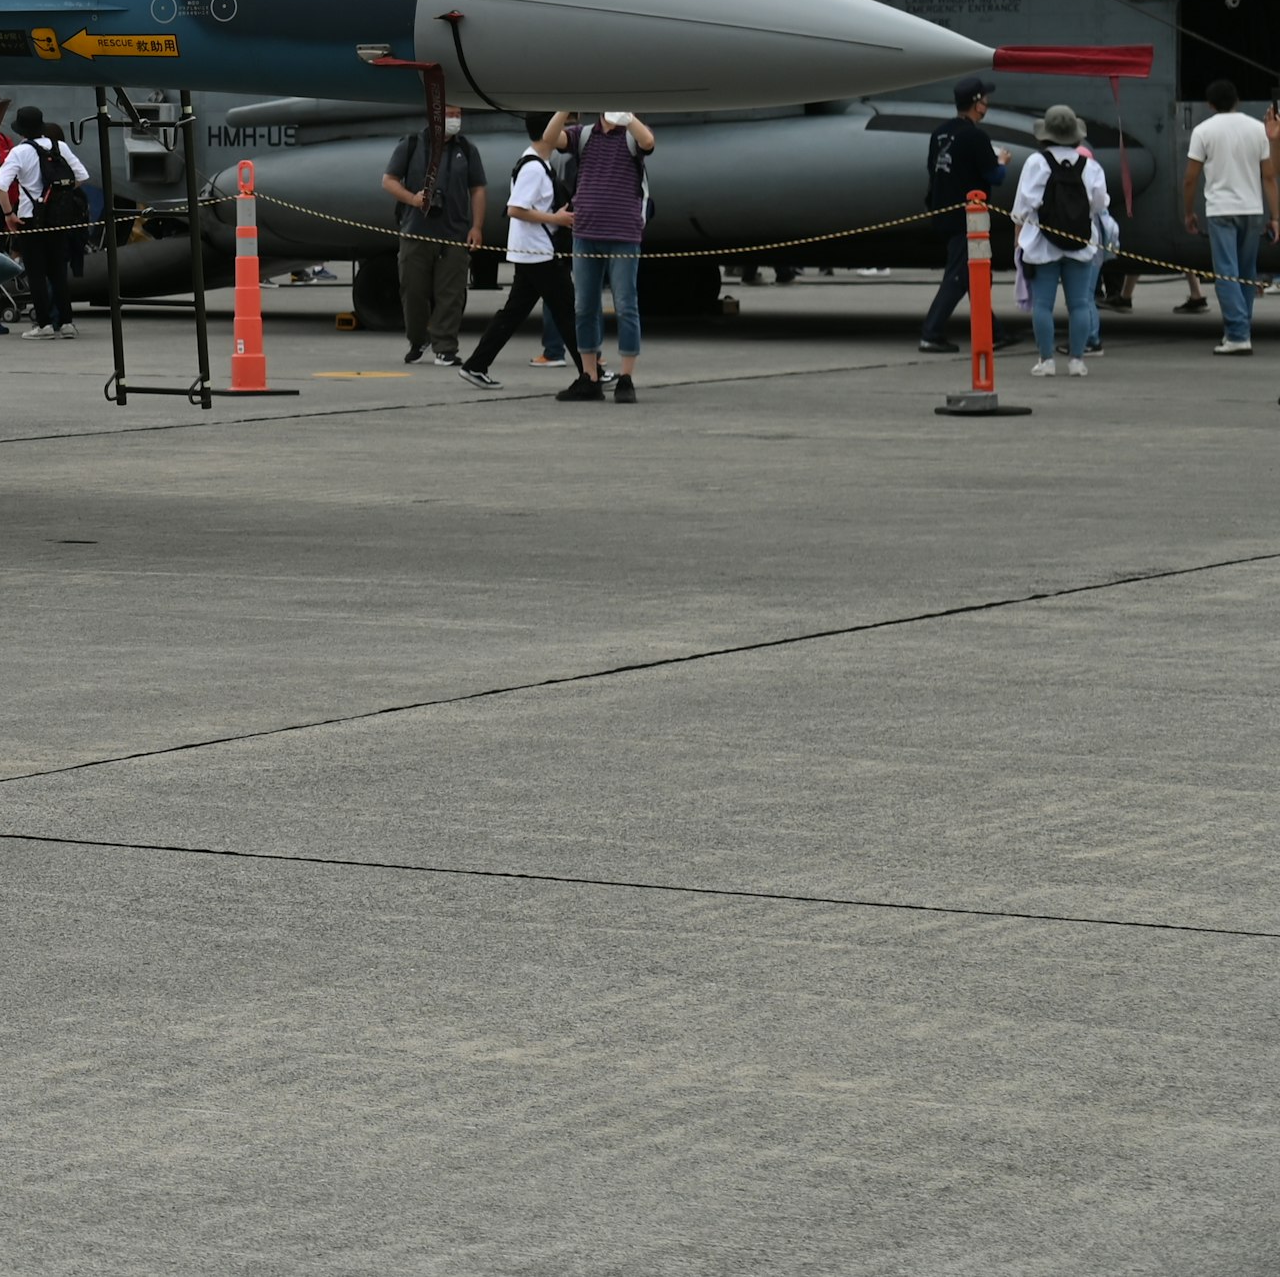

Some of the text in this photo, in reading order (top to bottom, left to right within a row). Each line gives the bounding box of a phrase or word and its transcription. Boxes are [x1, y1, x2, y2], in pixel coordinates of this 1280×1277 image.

[906, 3, 1021, 14] EMERGENCY ENTRANCE
[97, 38, 176, 52] RESCUE 救助用
